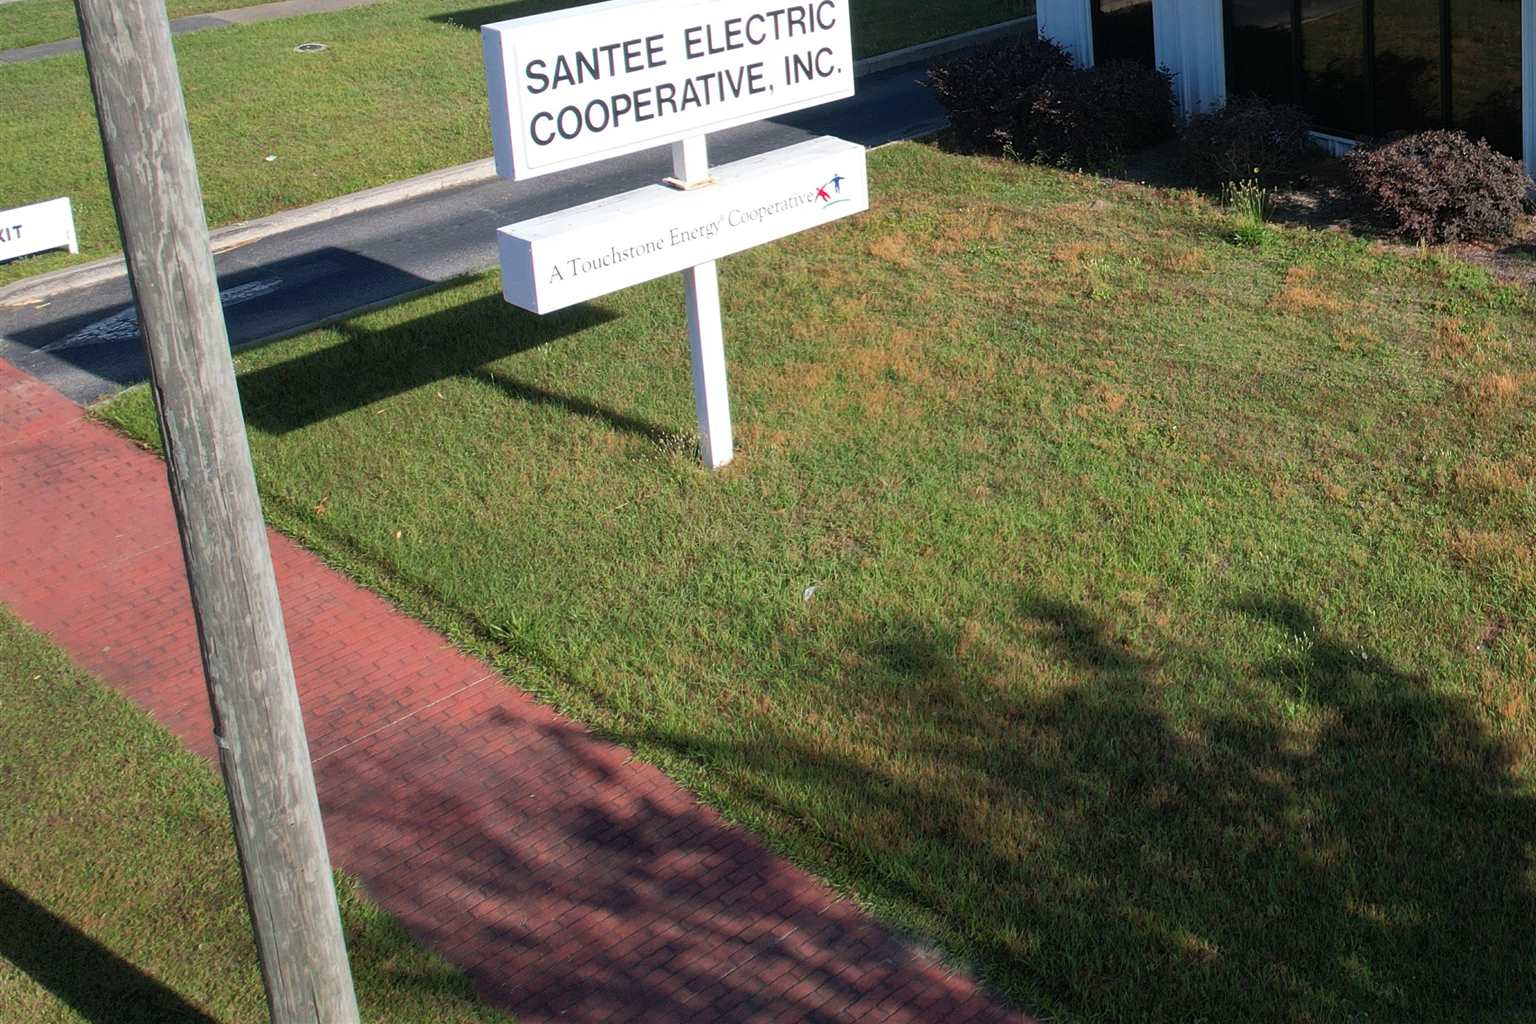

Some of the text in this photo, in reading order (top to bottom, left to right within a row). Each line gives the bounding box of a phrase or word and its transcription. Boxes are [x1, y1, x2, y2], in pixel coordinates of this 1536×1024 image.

[525, 0, 836, 95] SANTEE ELECTRIC
[529, 47, 843, 146] COOPERATIVE, INC.
[549, 264, 564, 284] A
[567, 237, 664, 277] Touchstone
[727, 189, 815, 227] Cooperative
